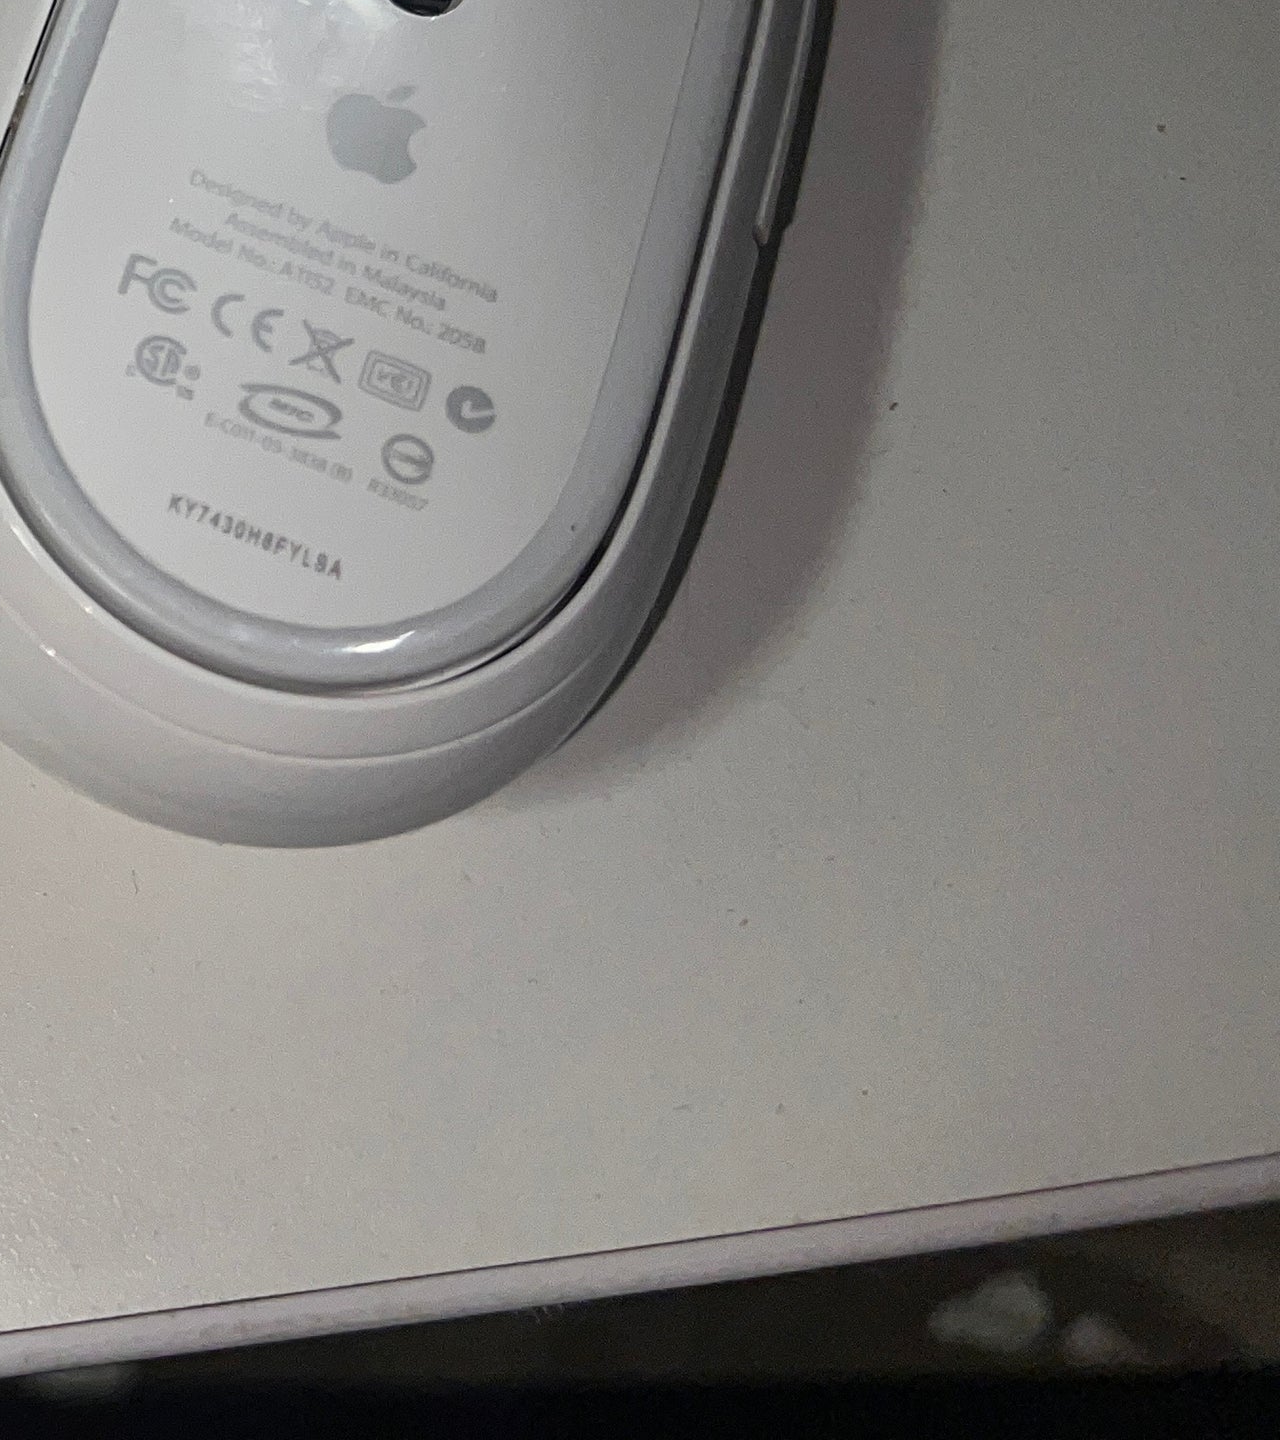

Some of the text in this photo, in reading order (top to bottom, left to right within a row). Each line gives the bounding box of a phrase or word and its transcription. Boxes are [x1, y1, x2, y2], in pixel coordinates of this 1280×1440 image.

[169, 217, 234, 255] Model
[344, 286, 391, 318] EMC
[190, 169, 498, 303] Designed by Apple in California
[225, 213, 336, 266] Assembled
[363, 265, 446, 311] Malaysia
